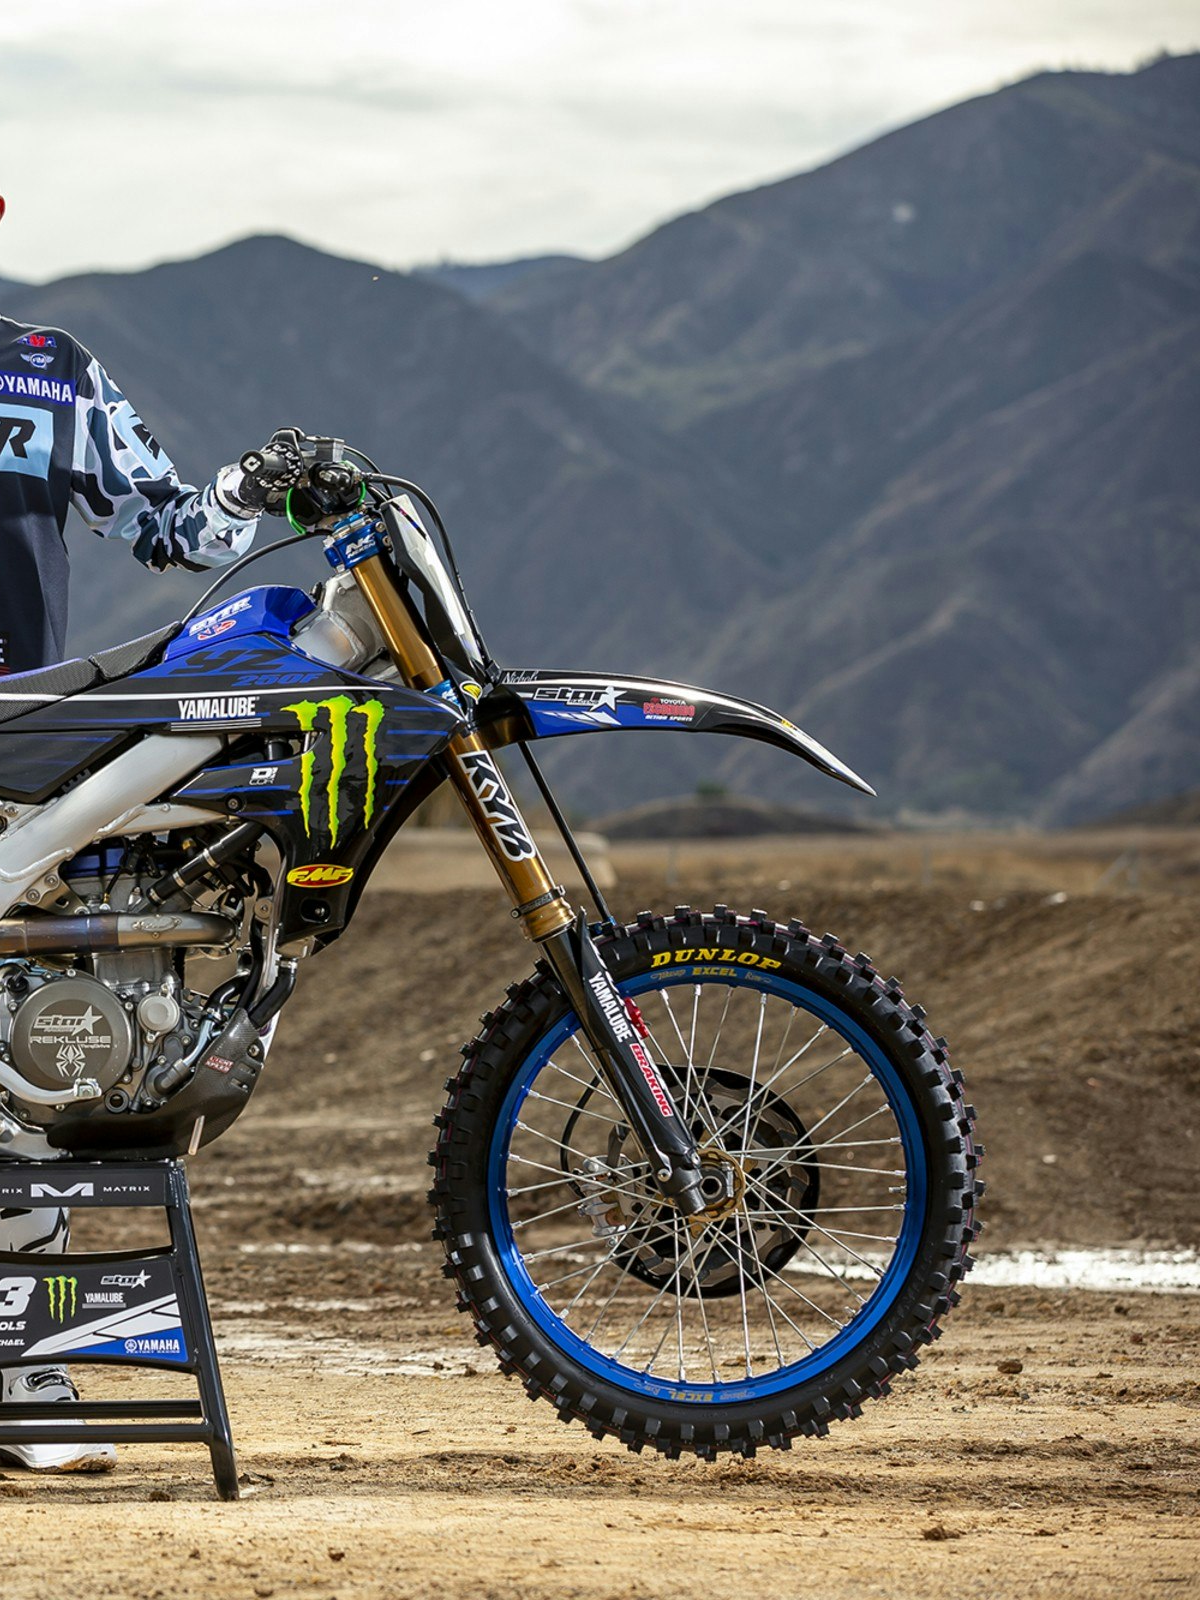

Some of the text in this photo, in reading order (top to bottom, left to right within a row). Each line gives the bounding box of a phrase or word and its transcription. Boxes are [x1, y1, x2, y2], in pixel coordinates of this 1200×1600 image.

[3, 375, 73, 402] YAMAHA
[231, 672, 324, 687] 250F
[178, 696, 257, 719] YAMALUBE
[456, 750, 536, 862] KYB
[287, 867, 353, 883] FMF
[650, 948, 782, 970] DUNLOP
[692, 967, 737, 977] EXCEL
[588, 971, 633, 1043] YAMALUBE
[30, 1035, 111, 1044] REKLUSE
[629, 1043, 674, 1117] BRAKING
[85, 1292, 124, 1303] YAMALUBE
[137, 1339, 180, 1350] YAMAHA
